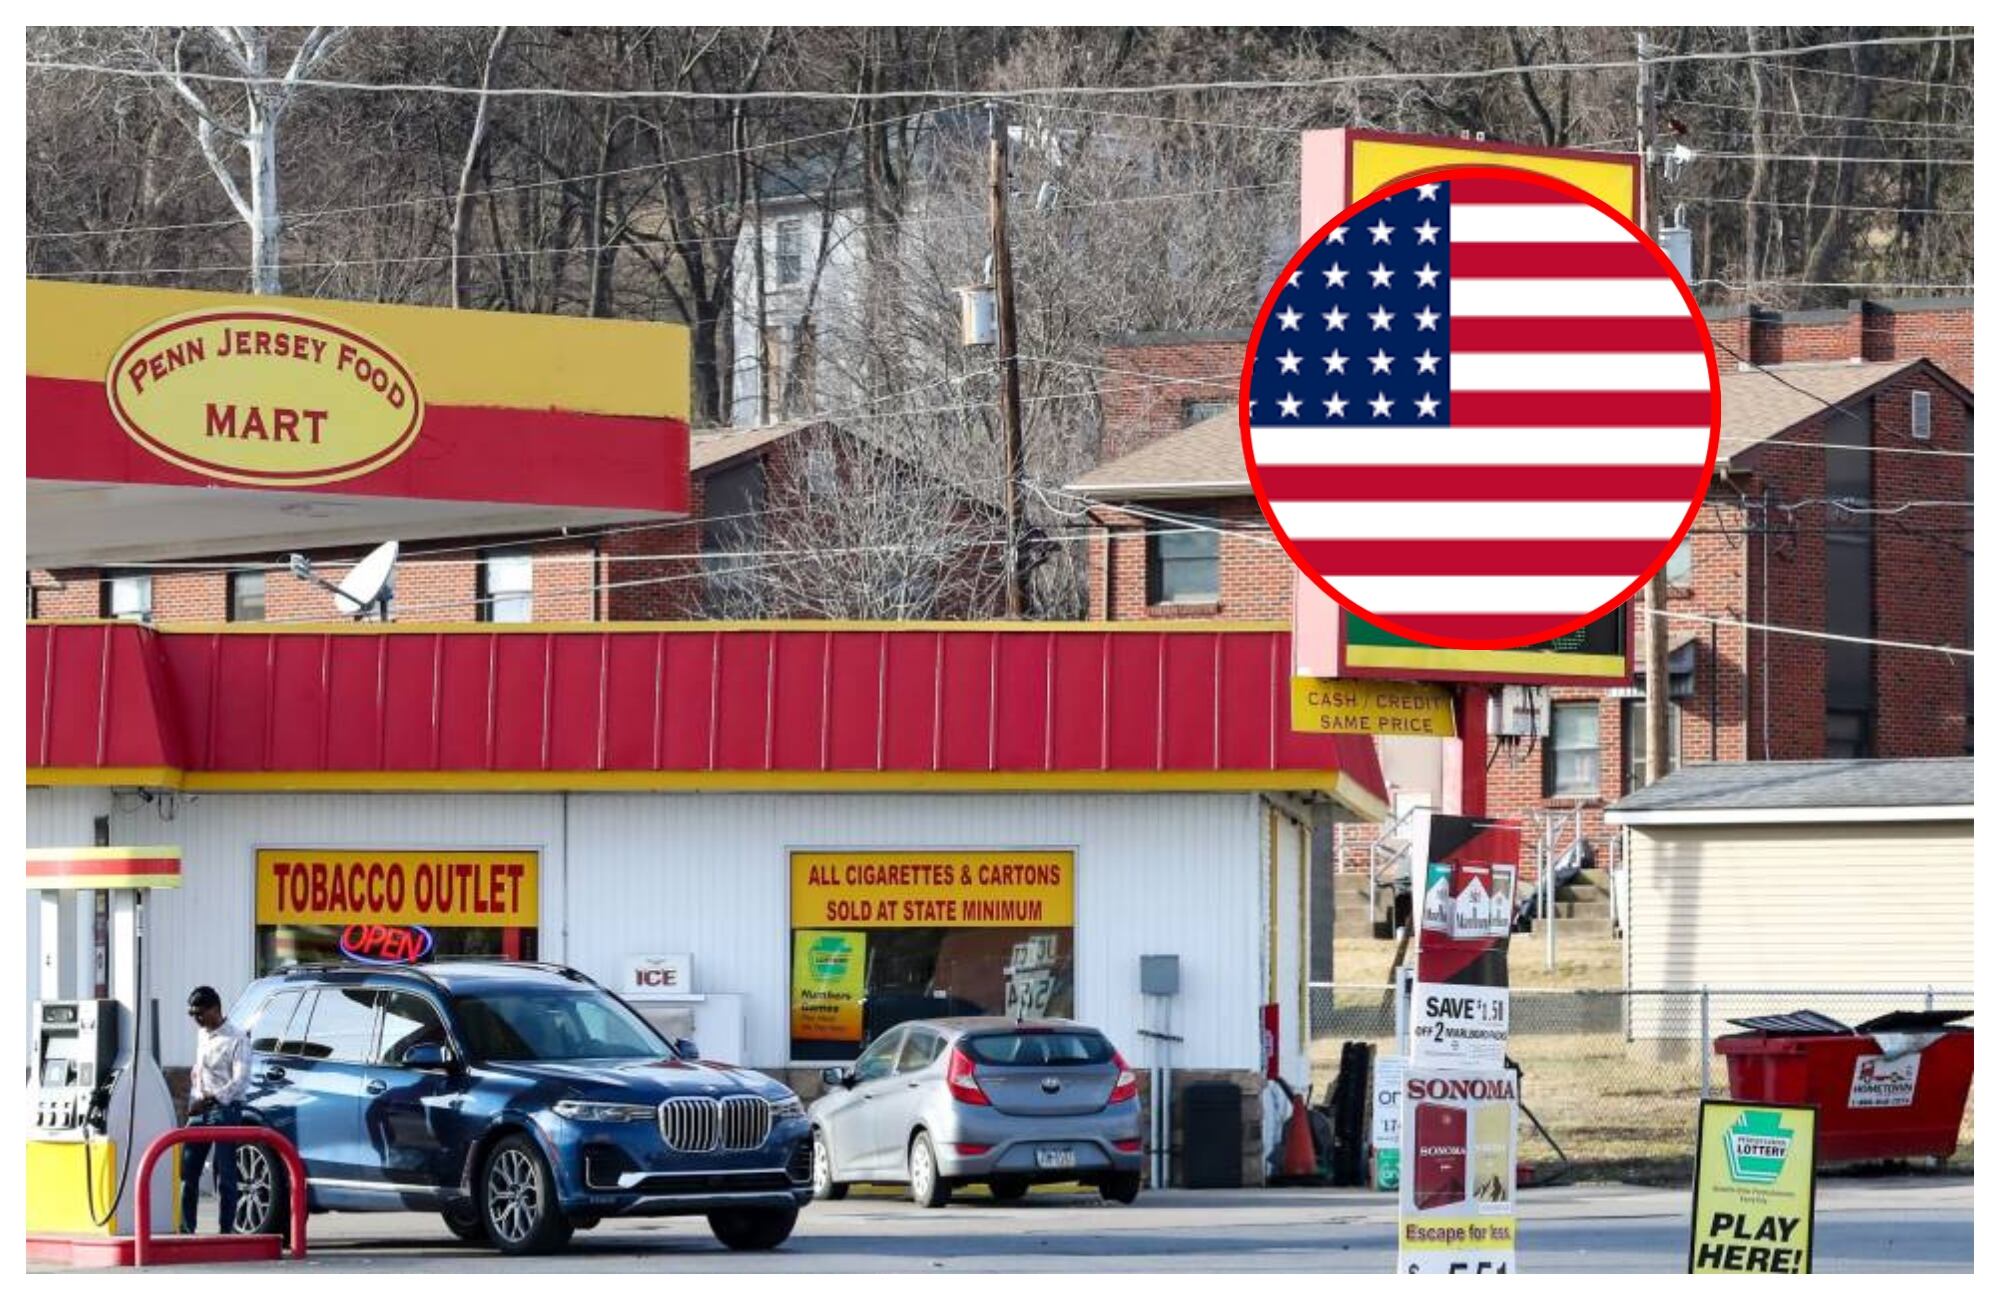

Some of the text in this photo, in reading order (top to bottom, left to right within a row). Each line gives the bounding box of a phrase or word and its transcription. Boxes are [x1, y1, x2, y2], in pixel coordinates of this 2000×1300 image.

[128, 328, 405, 410] PENN JERSEY FOOD
[206, 402, 328, 444] MART
[1308, 692, 1356, 709] CASH
[1376, 694, 1444, 711] CREDIT
[1320, 715, 1433, 733] SAME PRICE
[808, 865, 1061, 886] ALL CIGARETTES & CARTONS
[274, 862, 525, 914] TOBACCO OUTLET
[826, 900, 1042, 921] SOLD AT STATE MINIMUM
[342, 923, 424, 962] OPEN
[635, 969, 677, 987] ICE
[1426, 996, 1474, 1019] SAVE
[1415, 1026, 1432, 1037] OFF
[1434, 1021, 1444, 1042] 2
[1407, 1078, 1515, 1100] SONOMA
[1737, 1145, 1785, 1157] LOTTERY
[1406, 1224, 1465, 1246] Escape
[1469, 1224, 1486, 1241] for
[1710, 1212, 1801, 1243] PLAY
[1697, 1243, 1803, 1274] HERE!
